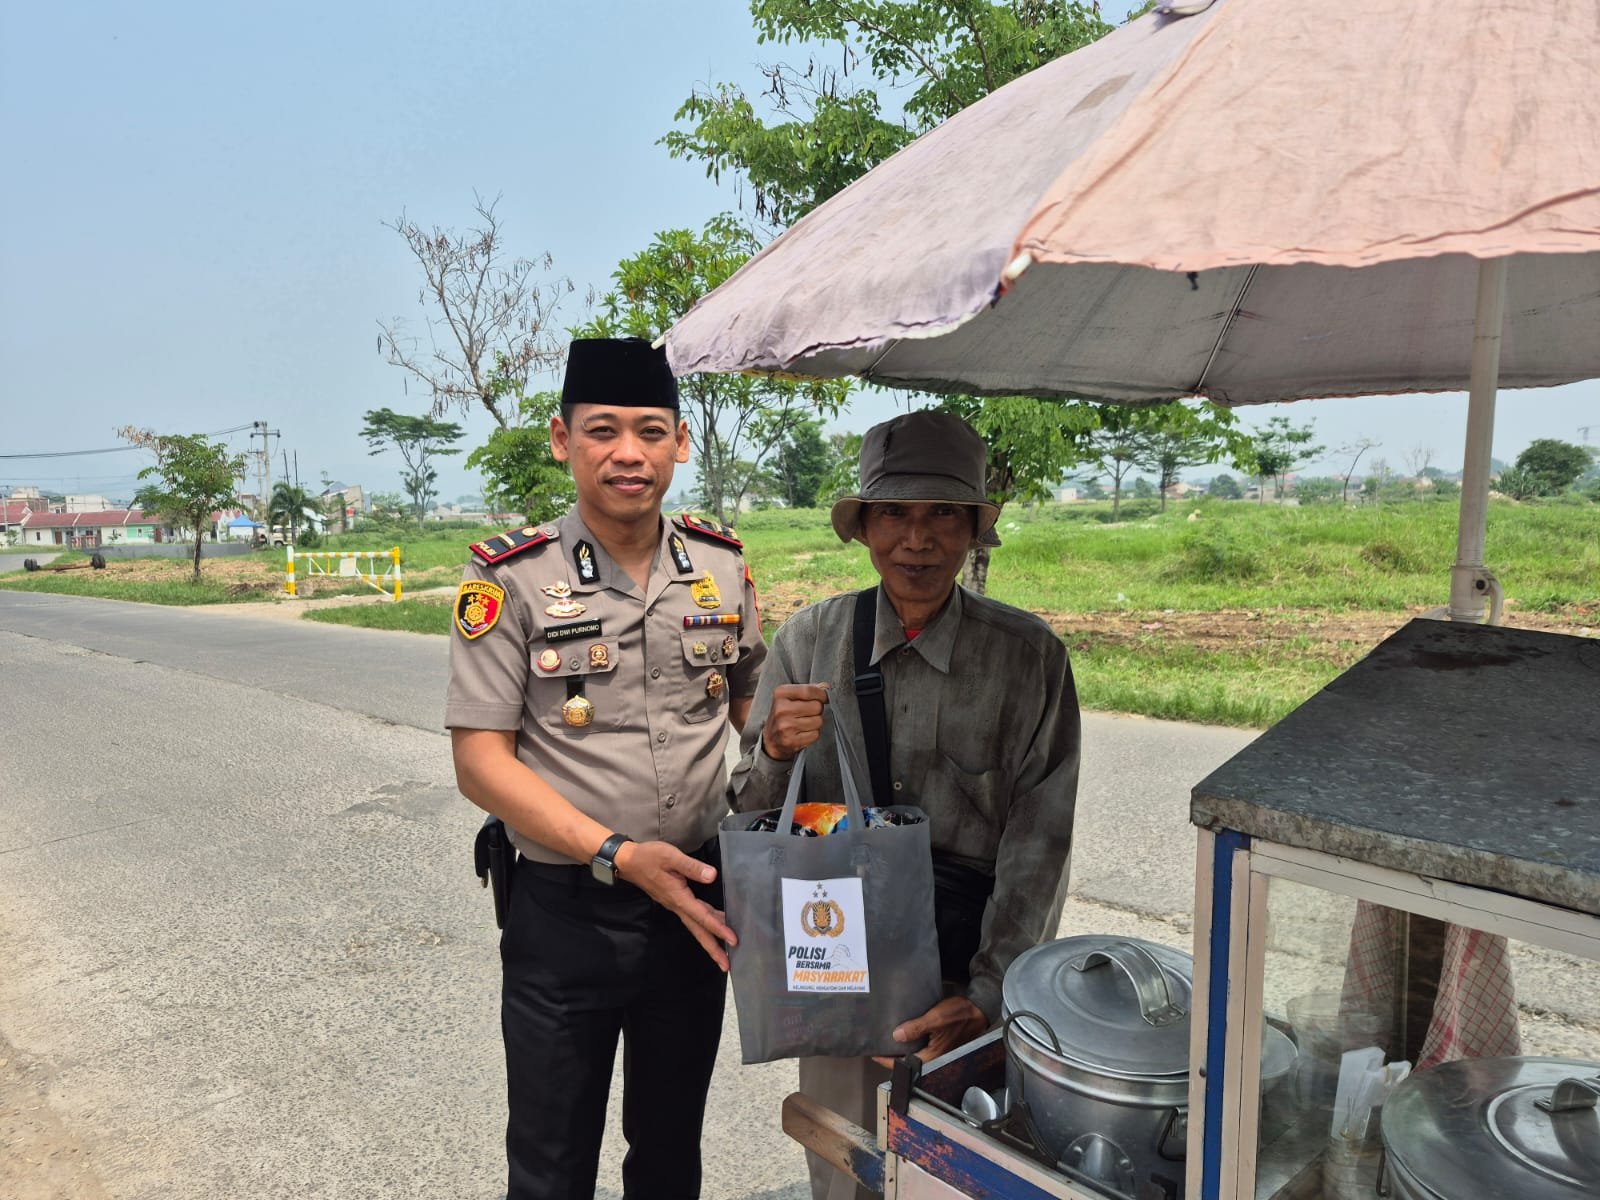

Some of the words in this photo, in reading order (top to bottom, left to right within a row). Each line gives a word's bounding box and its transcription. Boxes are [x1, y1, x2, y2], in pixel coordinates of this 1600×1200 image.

[547, 631, 559, 639] DIDI
[559, 629, 571, 637] DWI
[571, 624, 600, 634] PURNOMO
[788, 945, 827, 960] POLISI
[795, 960, 831, 970] BERSAMA
[792, 970, 867, 983] MASYARAKAT
